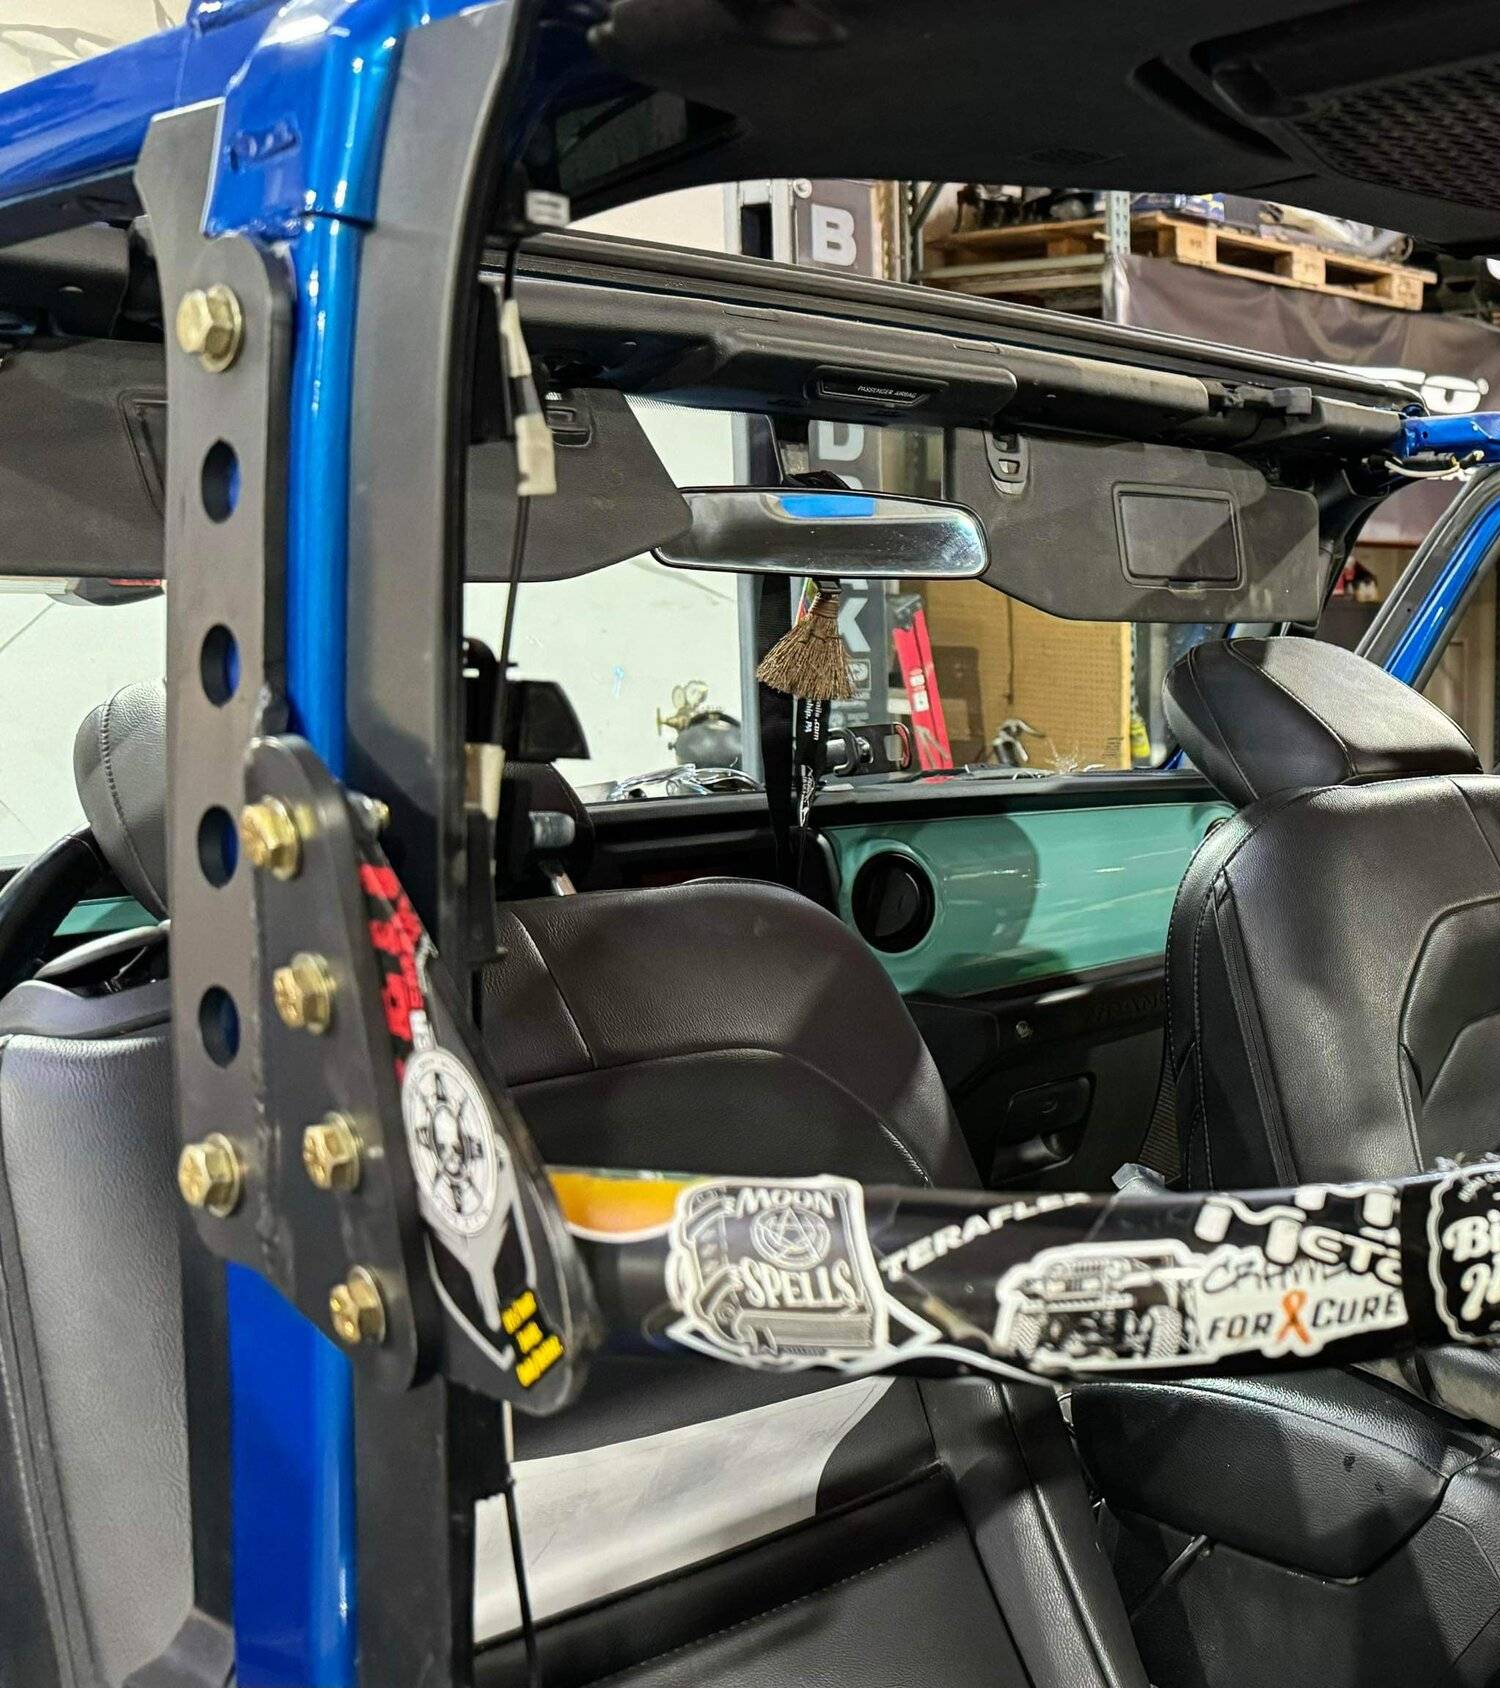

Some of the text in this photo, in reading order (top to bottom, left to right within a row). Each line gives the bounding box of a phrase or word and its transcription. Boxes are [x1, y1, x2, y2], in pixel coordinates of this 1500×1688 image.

[857, 385, 894, 395] PASSENGER
[736, 1186, 836, 1220] MOON
[738, 1256, 858, 1310] SPELLS
[1208, 1295, 1400, 1340] FOR CURE
